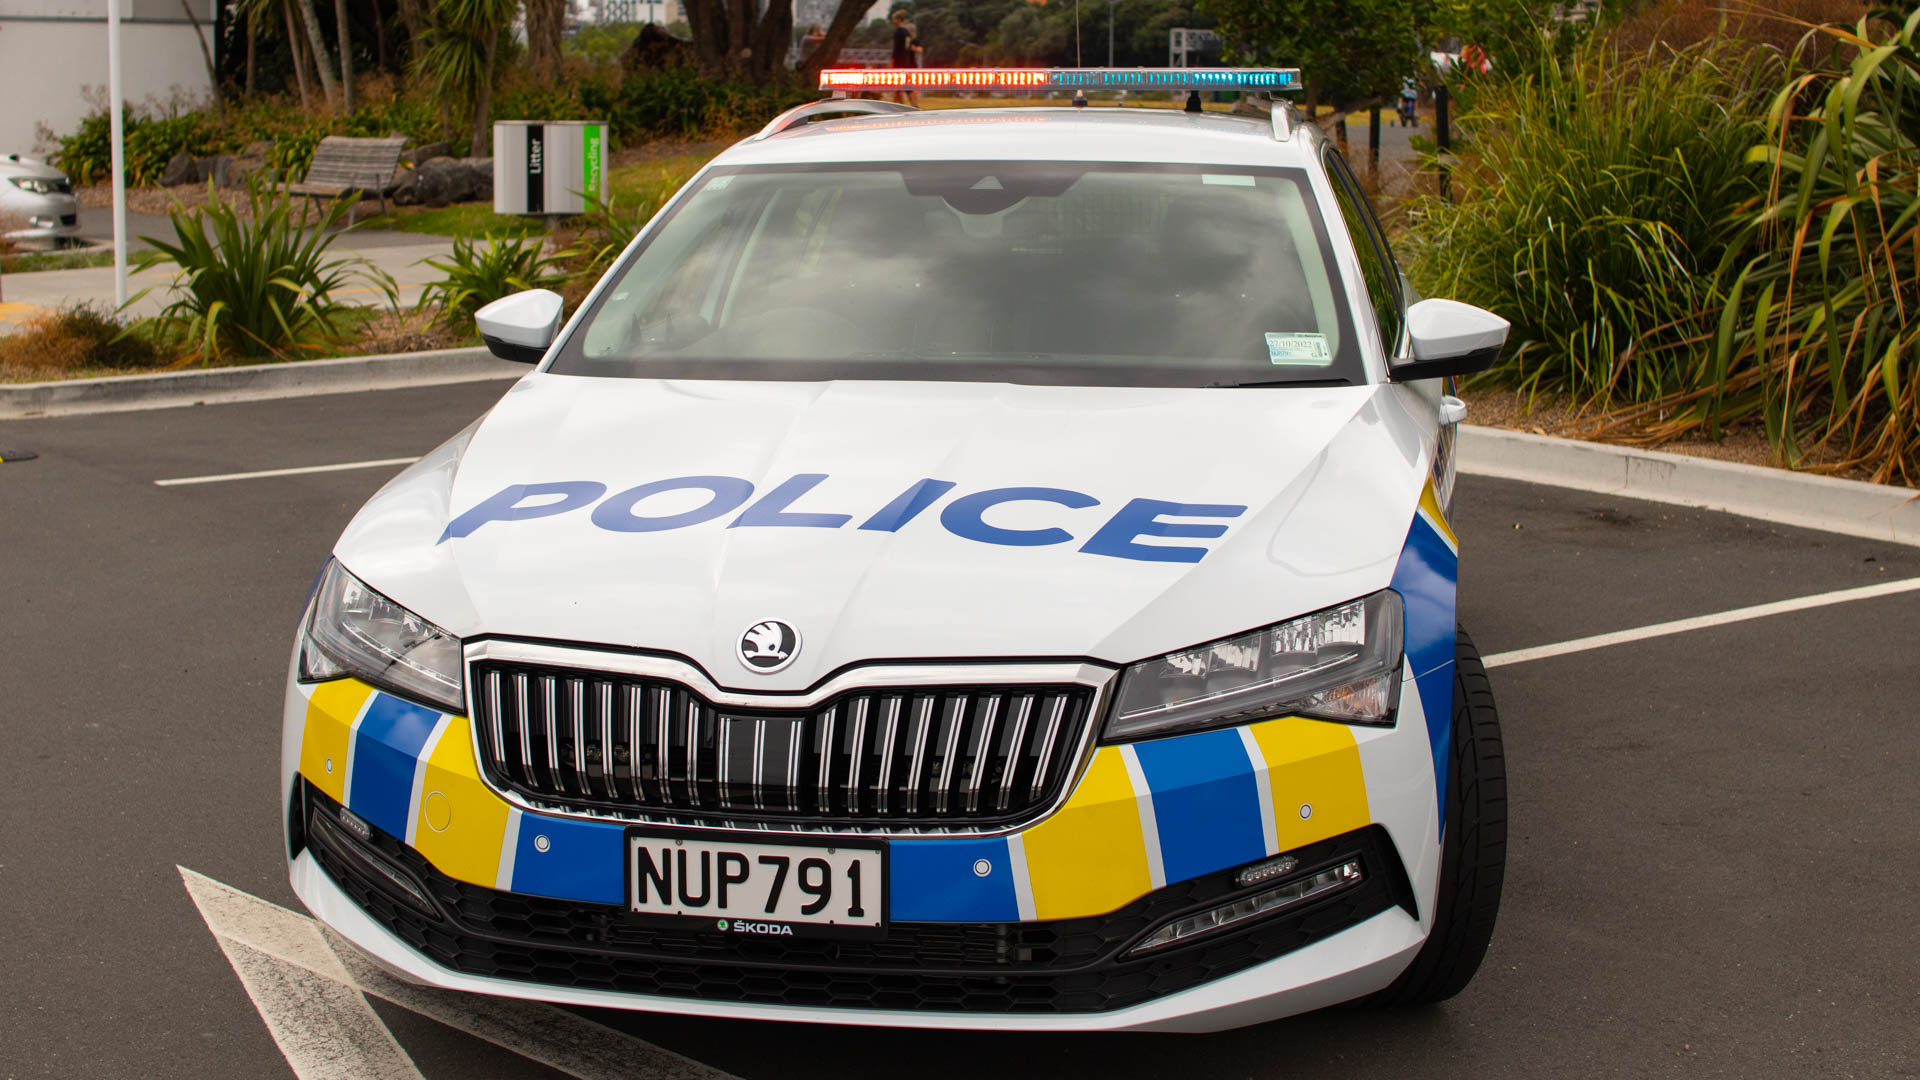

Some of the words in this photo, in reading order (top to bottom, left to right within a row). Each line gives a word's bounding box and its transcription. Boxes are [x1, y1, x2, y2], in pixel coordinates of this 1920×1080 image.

[529, 138, 541, 174] Litter
[588, 137, 600, 192] Recycling
[435, 474, 1247, 563] POLICE
[638, 846, 864, 917] NUP791
[733, 920, 793, 936] ŠKODA
